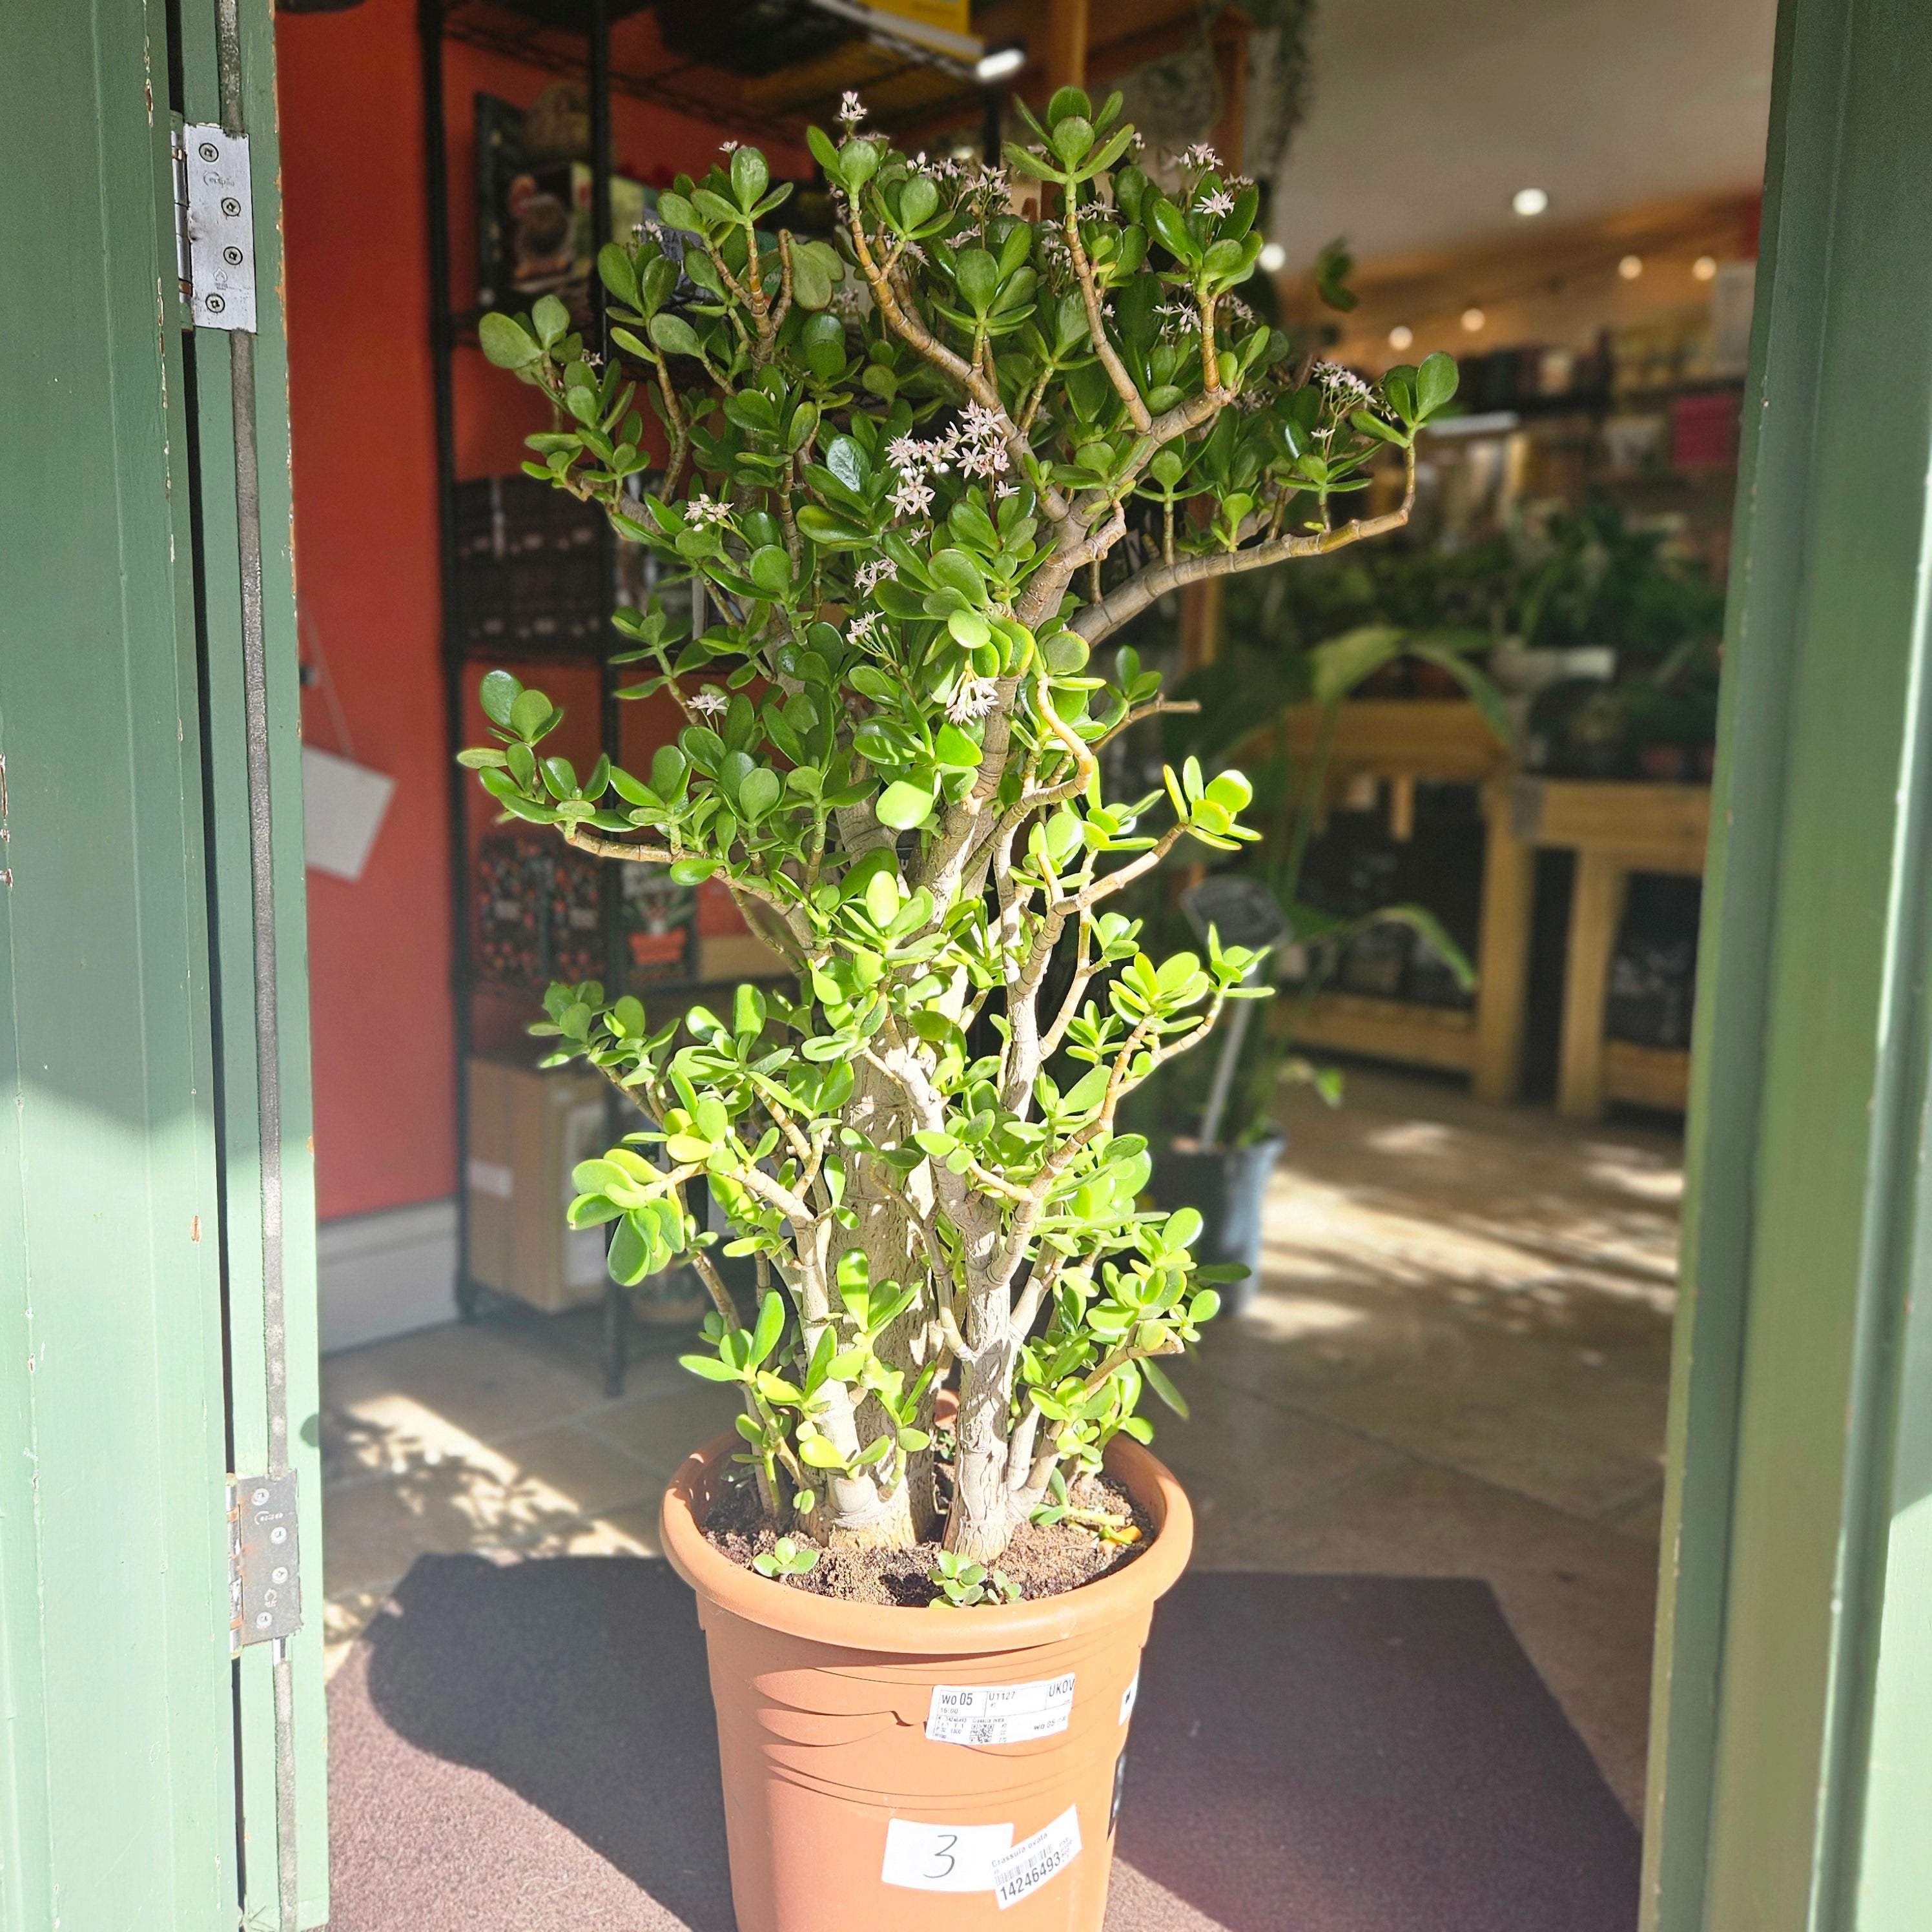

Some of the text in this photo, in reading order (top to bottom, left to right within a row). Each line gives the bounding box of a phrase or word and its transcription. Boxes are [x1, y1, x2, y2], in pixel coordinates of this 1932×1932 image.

[960, 1692, 973, 1706] 05
[989, 1691, 1015, 1701] U1127
[922, 1834, 958, 1878] 3
[991, 1832, 1048, 1867] Crassula ovata
[1000, 1851, 1061, 1900] 14246493
